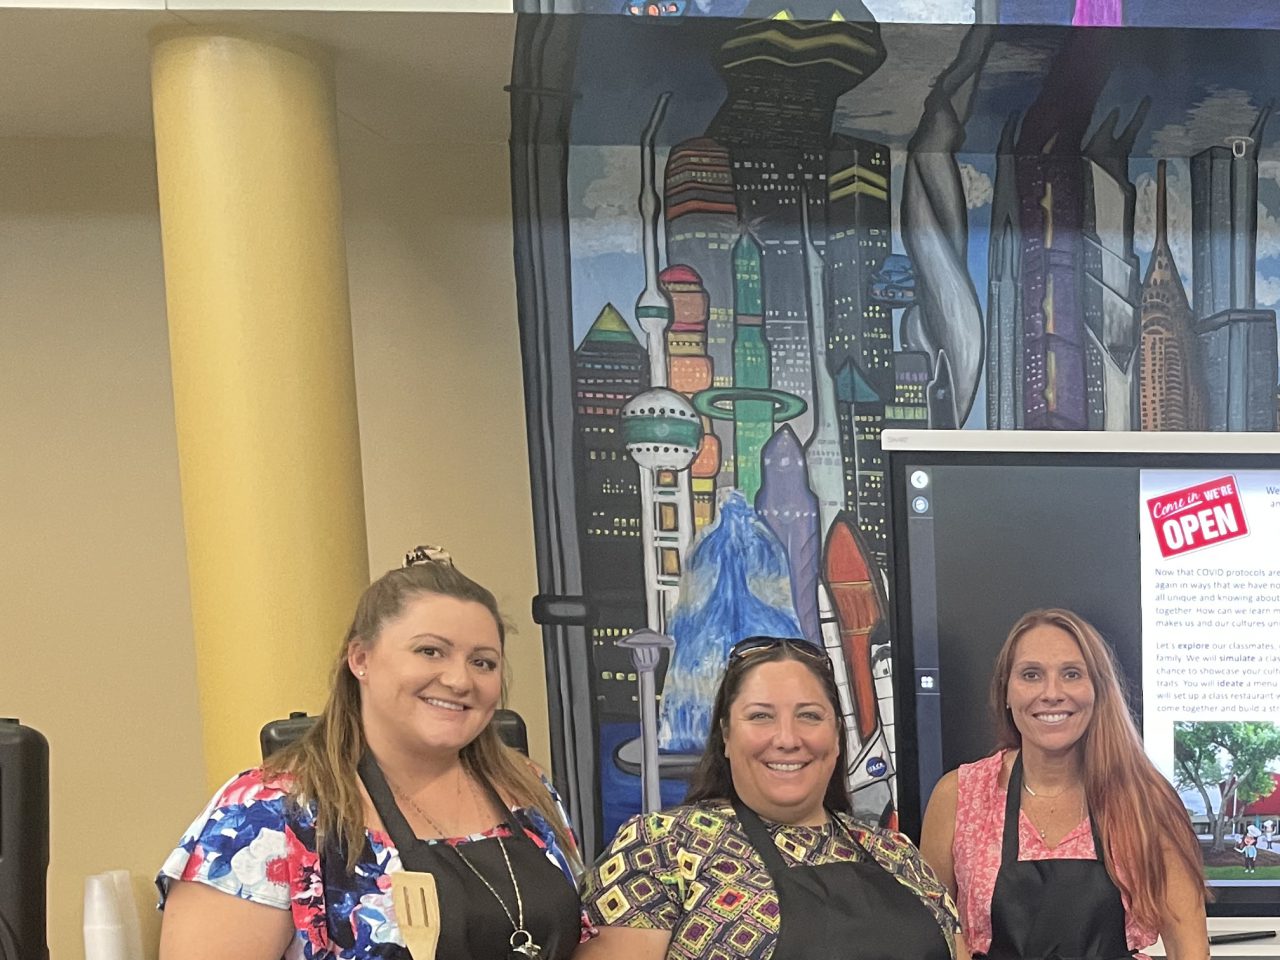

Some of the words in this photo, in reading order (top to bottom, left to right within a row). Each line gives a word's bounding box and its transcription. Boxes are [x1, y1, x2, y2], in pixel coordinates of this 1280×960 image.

[1153, 498, 1185, 518] Come
[1187, 492, 1201, 502] in
[1204, 484, 1233, 501] WE'RE
[1162, 503, 1238, 550] OPEN
[1154, 568, 1175, 577] Now
[1176, 568, 1195, 577] that
[1196, 568, 1225, 577] COVID
[1225, 568, 1266, 578] protocols
[1154, 581, 1178, 592] again
[1179, 581, 1188, 590] in
[1190, 583, 1212, 592] ways
[1213, 581, 1231, 590] that
[1247, 581, 1268, 590] have
[1154, 593, 1166, 602] all
[1167, 593, 1198, 604] unique
[1199, 593, 1216, 602] and
[1217, 593, 1254, 604] knowing
[1255, 593, 1280, 602] about
[1196, 606, 1215, 615] How
[1248, 606, 1271, 615] learn
[1155, 619, 1184, 628] makes
[1196, 619, 1214, 628] and
[1231, 619, 1266, 628] cultures
[1176, 641, 1211, 652] explore
[1185, 654, 1201, 663] We
[1202, 654, 1217, 663] will
[1218, 654, 1256, 663] simulate
[1155, 666, 1187, 675] chance
[1188, 666, 1198, 675] to
[1199, 666, 1240, 675] showcase
[1242, 668, 1261, 676] your
[1182, 679, 1199, 688] You
[1200, 679, 1215, 688] will
[1216, 679, 1245, 688] ideate
[1156, 691, 1171, 700] will
[1173, 691, 1187, 700] set
[1188, 693, 1200, 702] up
[1208, 691, 1229, 700] class
[1230, 691, 1274, 700] restaurant
[1220, 703, 1237, 712] and
[1238, 703, 1260, 712] build
